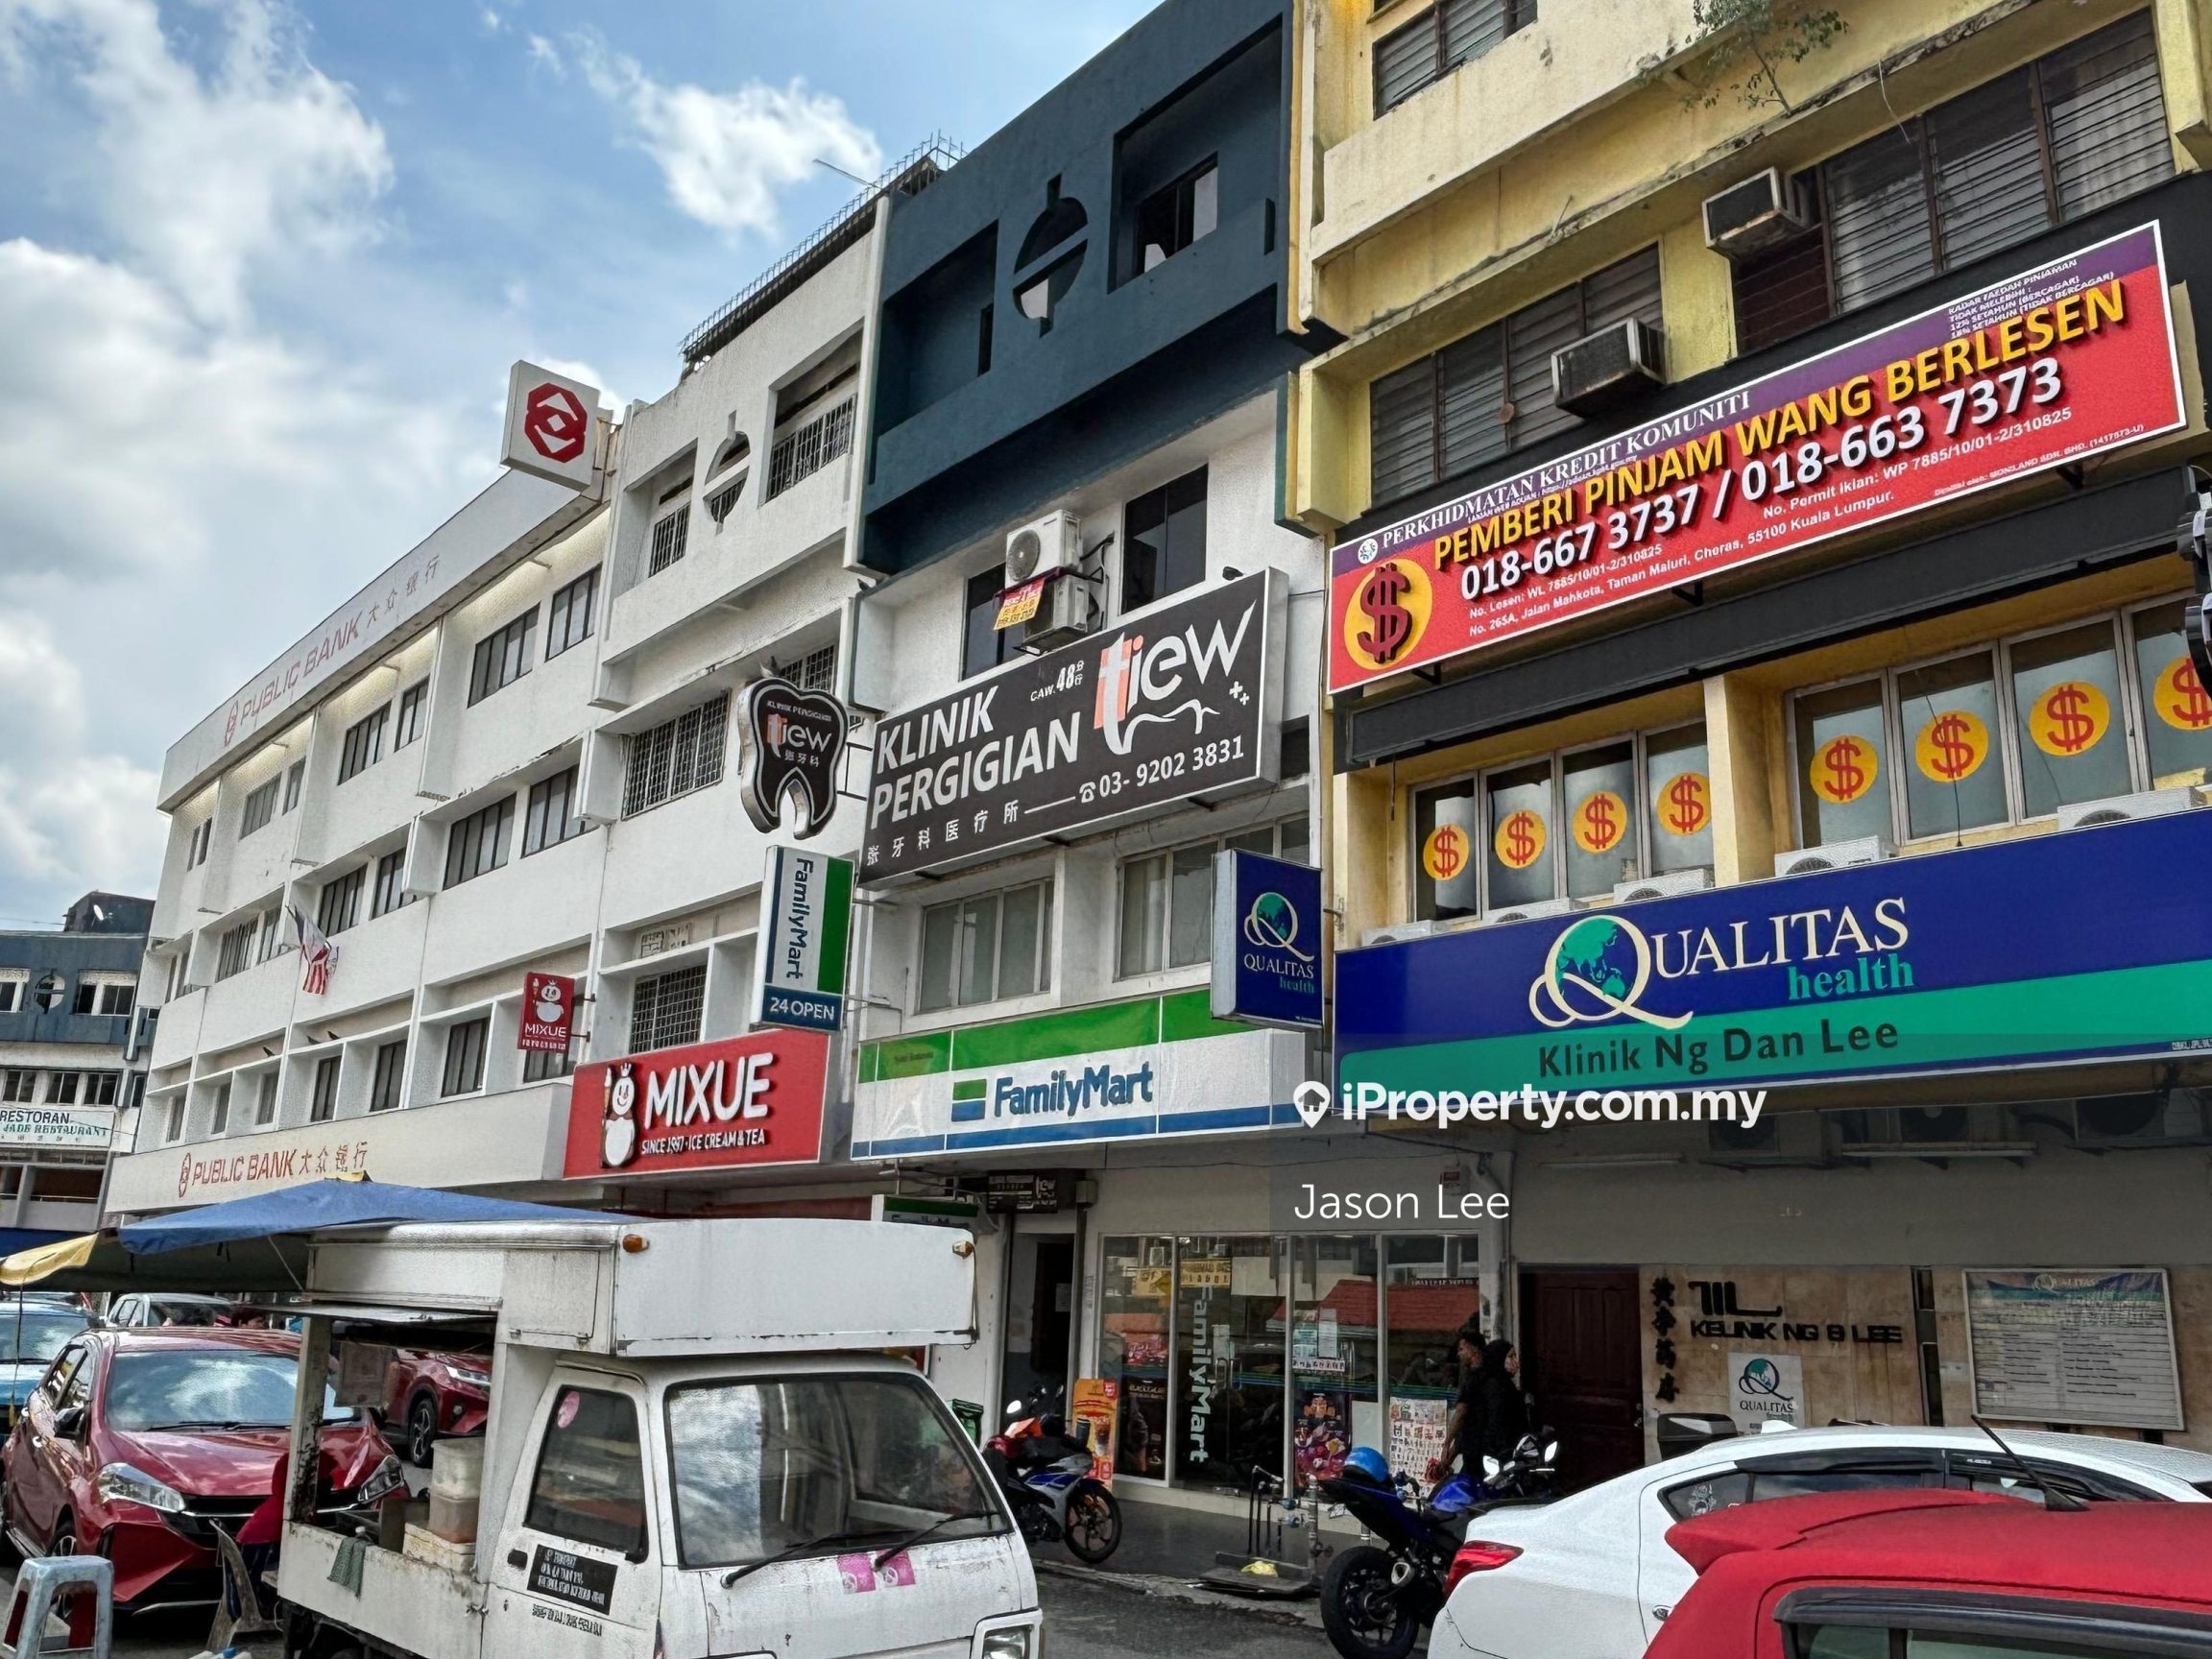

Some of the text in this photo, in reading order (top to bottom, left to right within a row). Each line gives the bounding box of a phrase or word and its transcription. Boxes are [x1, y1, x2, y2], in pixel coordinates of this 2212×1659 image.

[1950, 307, 1977, 323] TIDAK
[1971, 300, 2016, 324] SETAHUN
[1434, 488, 1574, 570] PEMBERI
[1585, 430, 1723, 515] PINJAM
[1735, 375, 1872, 454] WANG
[1885, 279, 2127, 403] BERLESEN
[1382, 477, 1533, 549] PERKHIDMATAN
[1540, 442, 1623, 488] KREDIT
[1626, 391, 1750, 454] KOMUNITI
[1460, 522, 1596, 602] 018-667
[1607, 484, 1698, 549] 3737
[1741, 407, 1925, 502] 018-663
[1940, 357, 2062, 434] 7373
[1764, 504, 1787, 518] No.
[1791, 484, 1836, 509] Permit
[1883, 462, 1908, 479] WP
[1911, 408, 2073, 470] 7885/10/01-2/310825
[1469, 624, 1487, 636] No.
[1522, 603, 1550, 620] Jalan
[1553, 587, 1604, 608] Mahkota,
[1608, 571, 1647, 590] Taman
[1649, 555, 1691, 577] Maluri,
[1747, 523, 1787, 544] 55100
[1791, 510, 1830, 531] Kuala
[1835, 493, 1894, 519] Lumpur.
[1469, 607, 1487, 619] No.
[1527, 585, 1545, 597] WL
[240, 611, 363, 726] PUBLIC BANK
[1056, 664, 1075, 691] 48
[1094, 599, 1257, 756] tiew
[767, 713, 832, 757] tiew
[877, 685, 999, 774] KLINIK
[871, 711, 1081, 830] PERGIGIAN
[1137, 753, 1186, 787] 9202
[1192, 734, 1244, 771] 3831
[786, 858, 813, 979] FamilyMart
[1244, 953, 1314, 978] QUALITAS
[1280, 975, 1314, 994] health
[1529, 897, 1910, 1029] QUALITAS
[1788, 953, 1914, 1001] health
[525, 1022, 566, 1037] MIXUE
[1539, 1019, 1899, 1078] Klinik Ng Dan Lee
[0, 1110, 70, 1124] RESTORAN
[645, 1052, 773, 1129] MIXUE
[994, 1061, 1153, 1118] FamilyMart
[192, 1149, 297, 1186] PUBLIC BANK
[642, 1139, 666, 1155] SINCE
[705, 1132, 736, 1149] CREAM
[745, 1128, 765, 1144] TEA
[1783, 1322, 1819, 1341] NG
[1851, 1325, 1903, 1344] LEE
[1190, 1285, 1213, 1463] FamilyMart
[1740, 1400, 1794, 1414] QUALITAS
